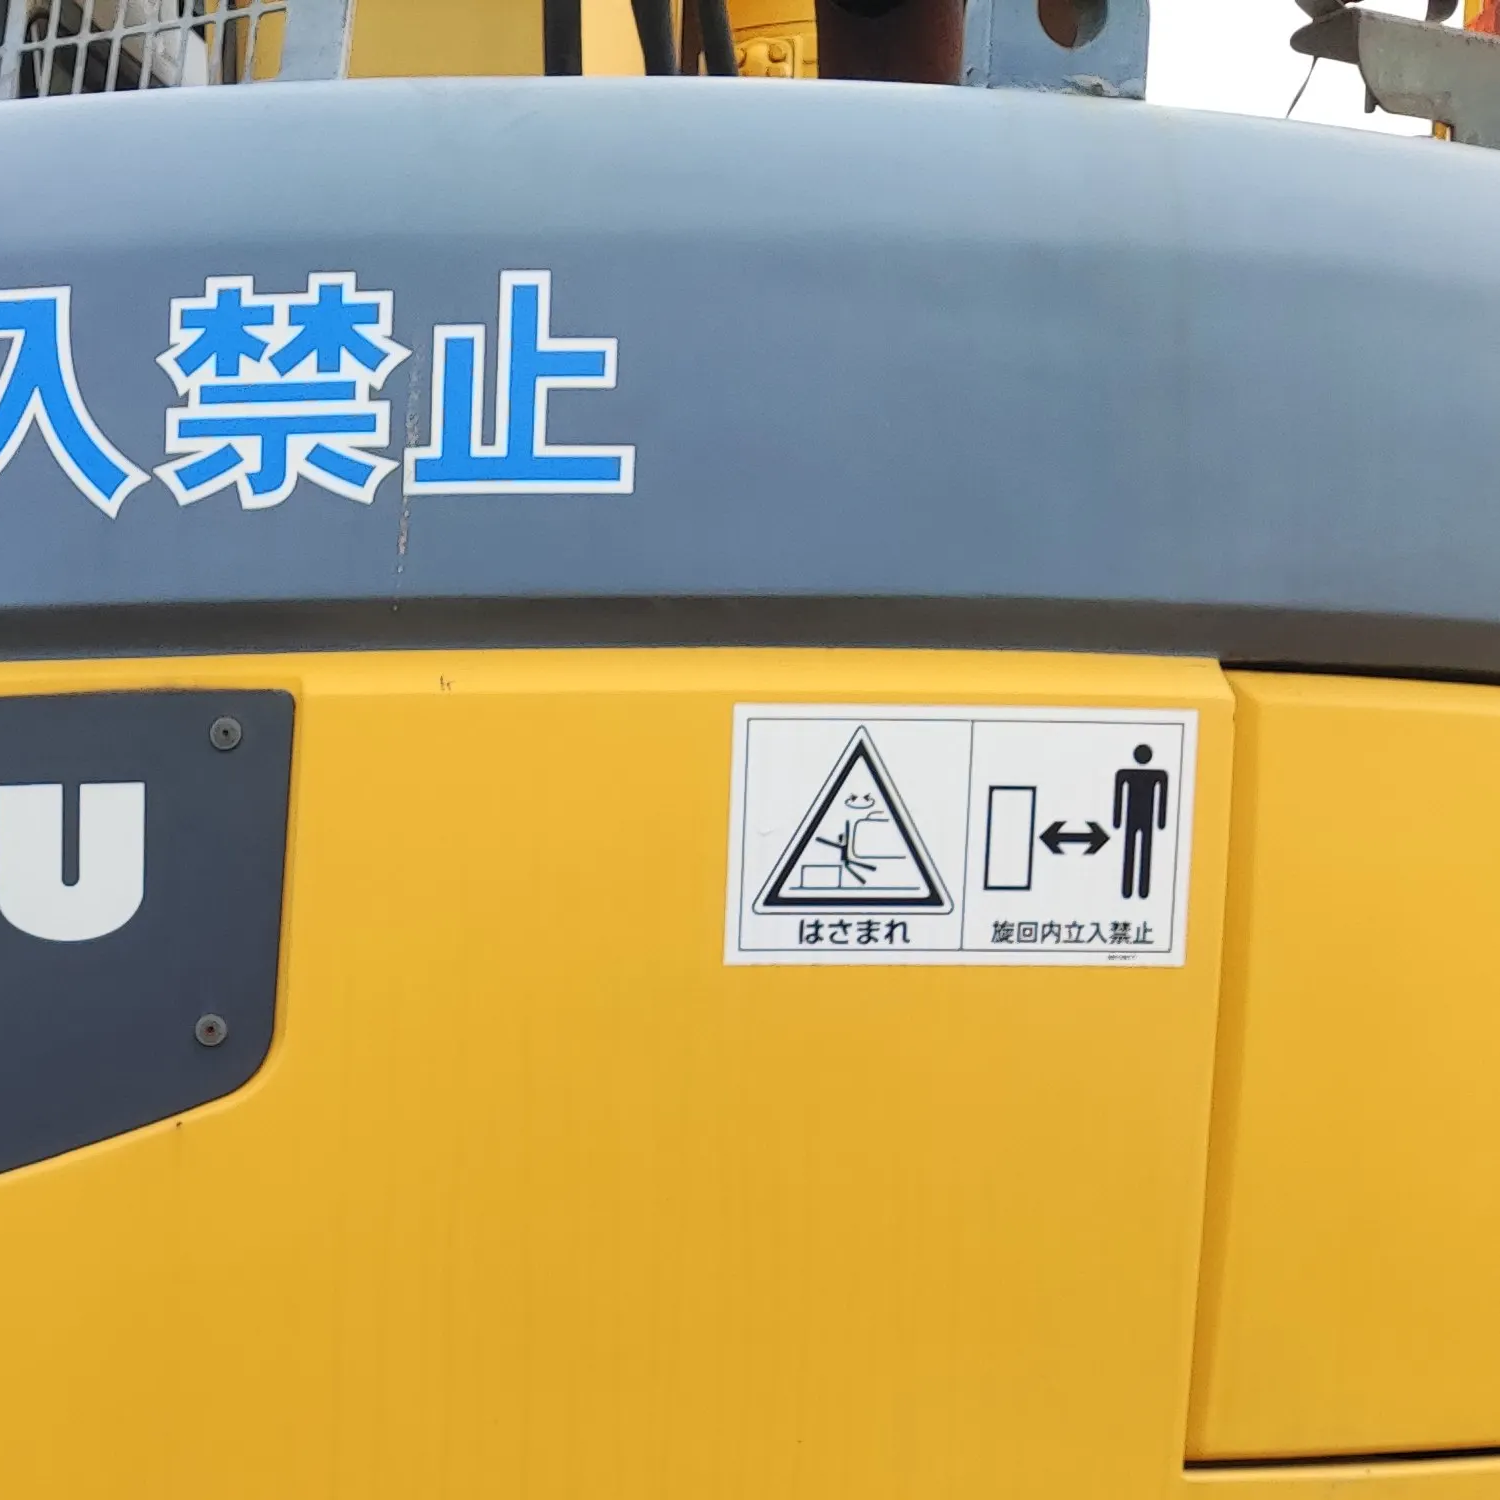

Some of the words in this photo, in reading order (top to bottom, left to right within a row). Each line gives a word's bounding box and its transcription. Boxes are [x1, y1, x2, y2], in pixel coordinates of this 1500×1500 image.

[798, 919, 911, 945] はさまれ
[990, 920, 1155, 945] 旋回内立入禁止
